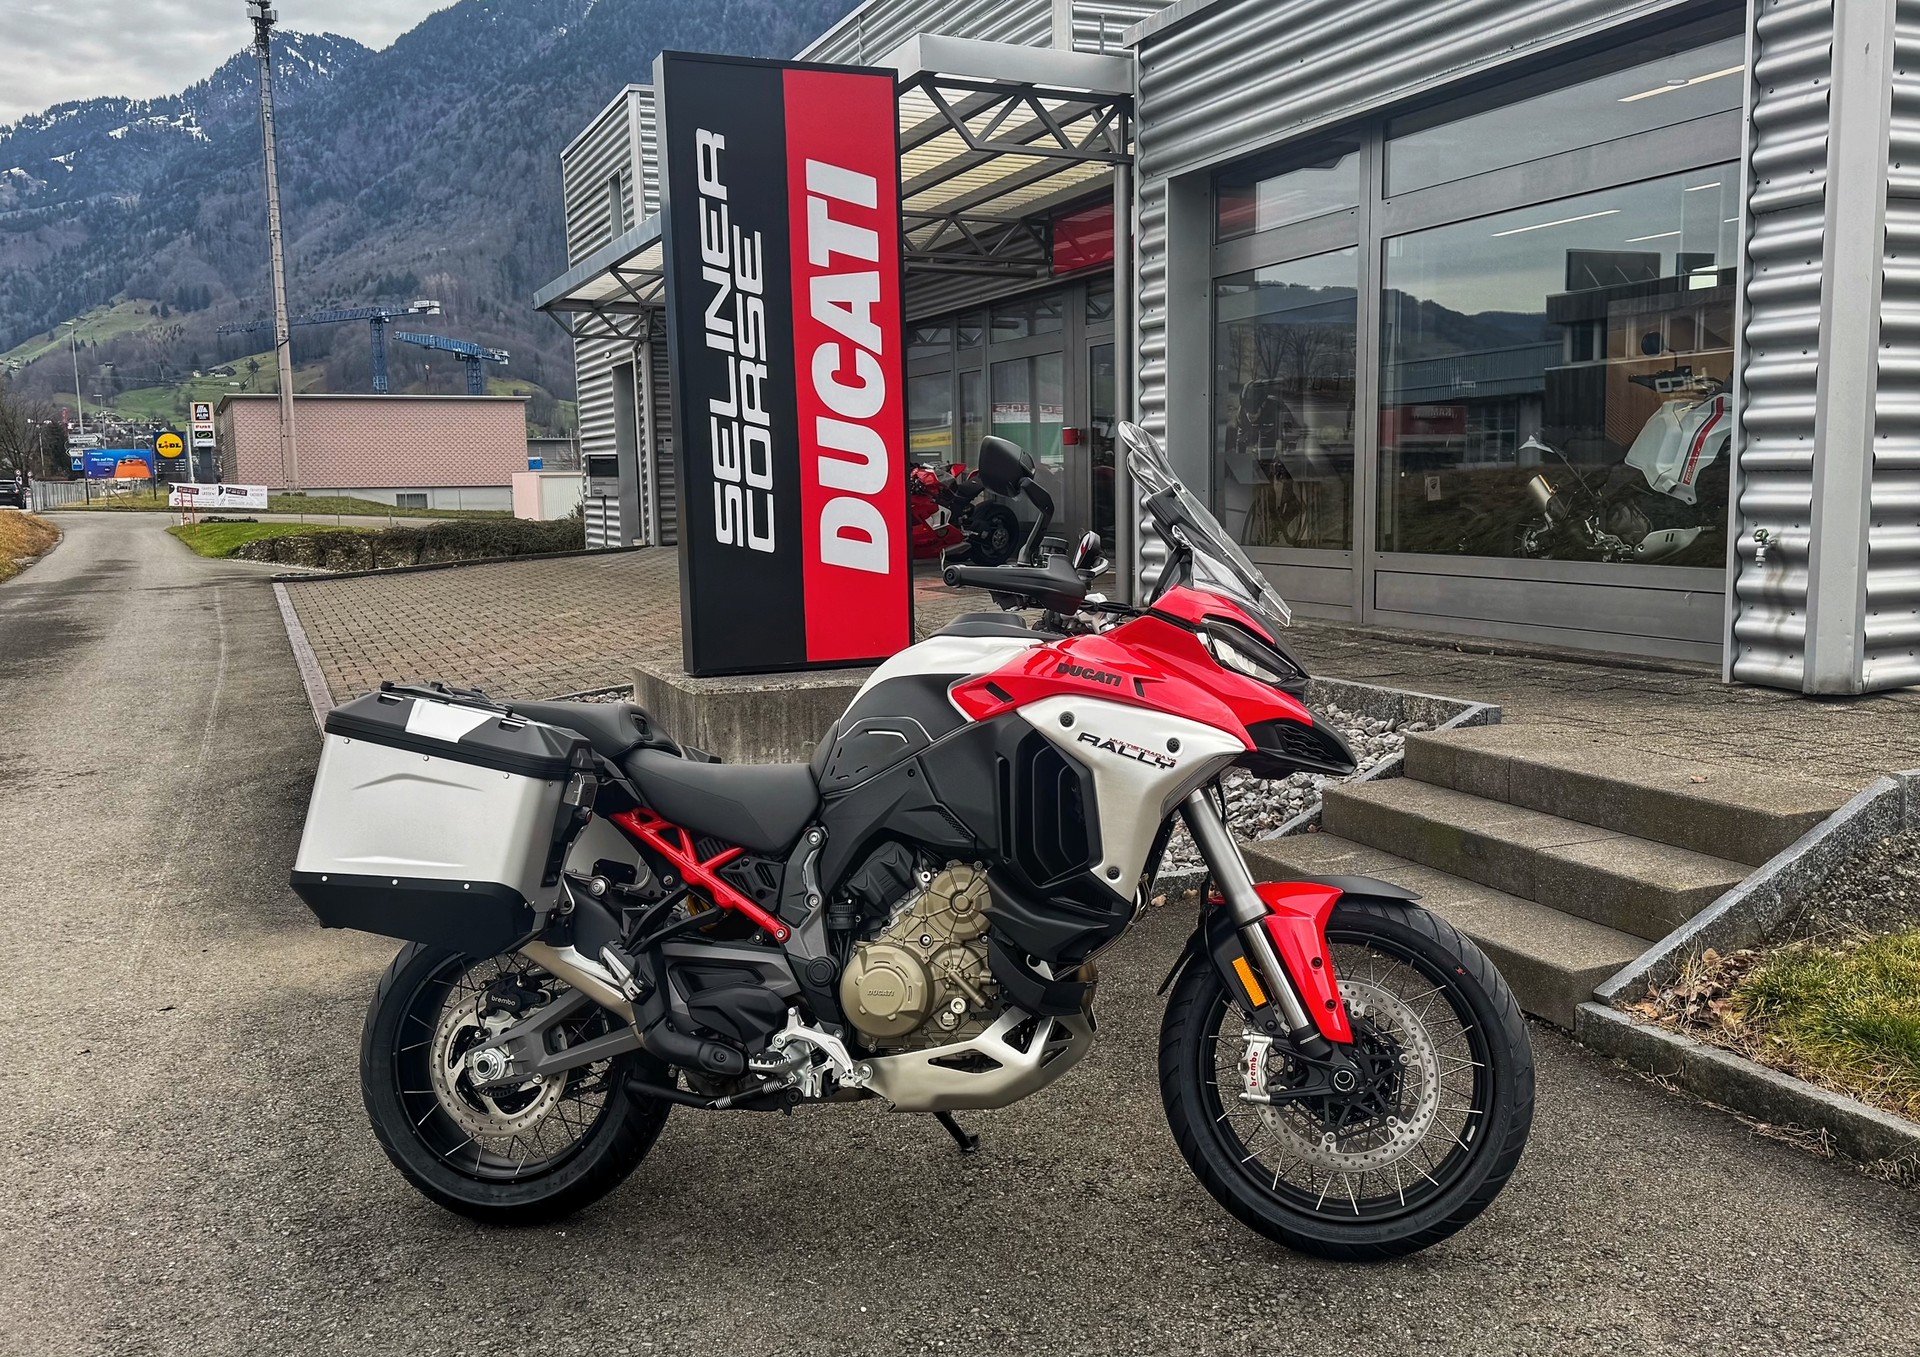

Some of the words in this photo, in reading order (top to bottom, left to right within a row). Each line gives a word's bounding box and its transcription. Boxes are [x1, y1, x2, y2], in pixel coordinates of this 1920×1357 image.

[695, 127, 745, 547] SELINER
[805, 157, 890, 574] DUCATI
[732, 224, 776, 554] CORSE
[1056, 662, 1122, 687] DUCATI
[1077, 732, 1176, 770] RALLY
[1108, 738, 1165, 760] MULTISTRADA
[491, 995, 516, 1006] brembo
[867, 989, 895, 997] DUCATI
[1249, 1051, 1259, 1087] brembo
